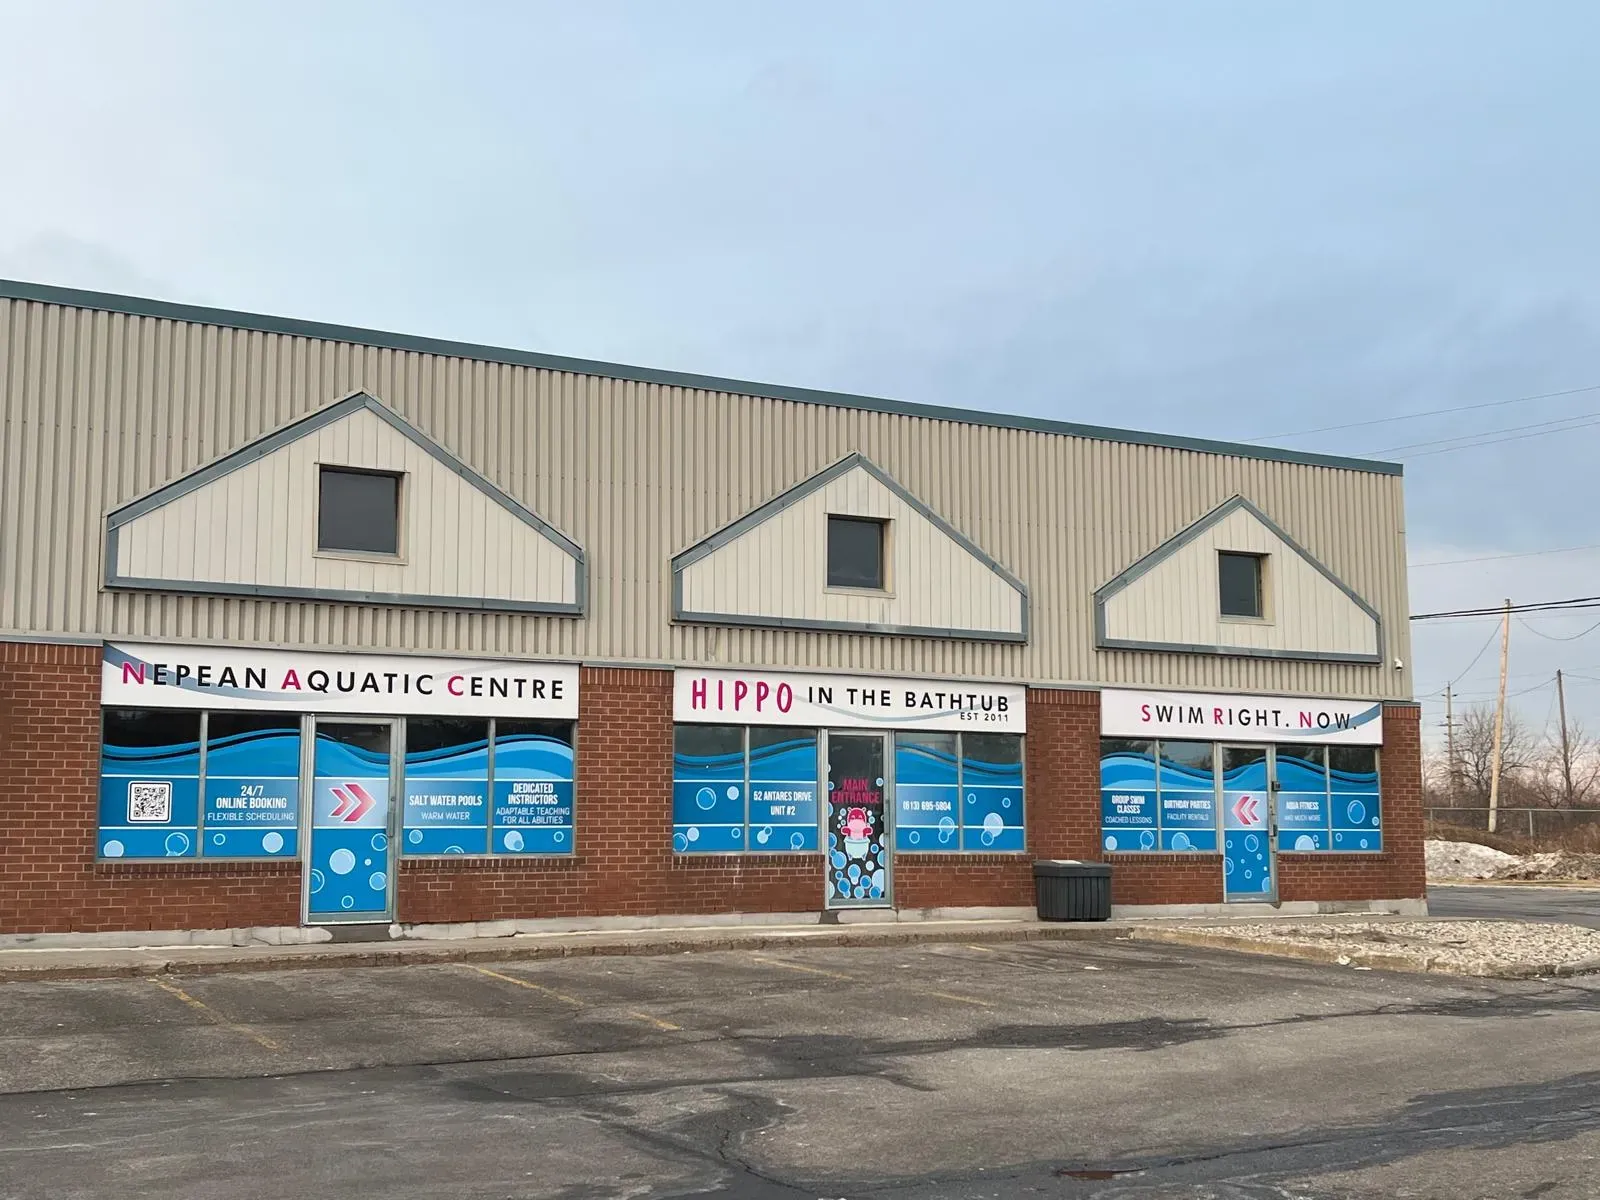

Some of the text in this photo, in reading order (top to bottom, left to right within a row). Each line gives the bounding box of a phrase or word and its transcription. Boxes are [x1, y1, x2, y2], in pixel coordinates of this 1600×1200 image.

[122, 662, 563, 700] NEPEAN AQUATIC CENTRE
[692, 678, 1009, 713] HIPPO IN THE BATHTUB
[960, 712, 1009, 722] EST 2011
[1141, 704, 1357, 730] SWIM RIGHT. NOW.
[513, 782, 554, 794] DEDICATED
[843, 778, 868, 791] MAIN
[241, 785, 264, 797] 24/7
[763, 790, 793, 801] ANTARES
[793, 791, 812, 801] DRIVE
[409, 794, 483, 806] SALT WATER POOLS
[507, 794, 559, 805] INSTRUCTORS
[831, 791, 880, 804] ENTRANCE
[1111, 795, 1129, 804] GROUP
[216, 797, 287, 809] ONLINE BOOKING
[1163, 799, 1211, 809] BIRTHDAY PARTIES
[496, 806, 570, 816] ADAPTABLE TEACHING
[770, 805, 796, 815] UNIT #2
[1116, 804, 1140, 814] CLASSES
[207, 812, 294, 821] FLEXIBLE SCHEDULING
[421, 811, 470, 820] WARM WATER
[502, 815, 564, 824] FOR ALL ABILITIES
[1105, 816, 1152, 824] COACHED LESSONS
[1166, 812, 1187, 820] FACILITY
